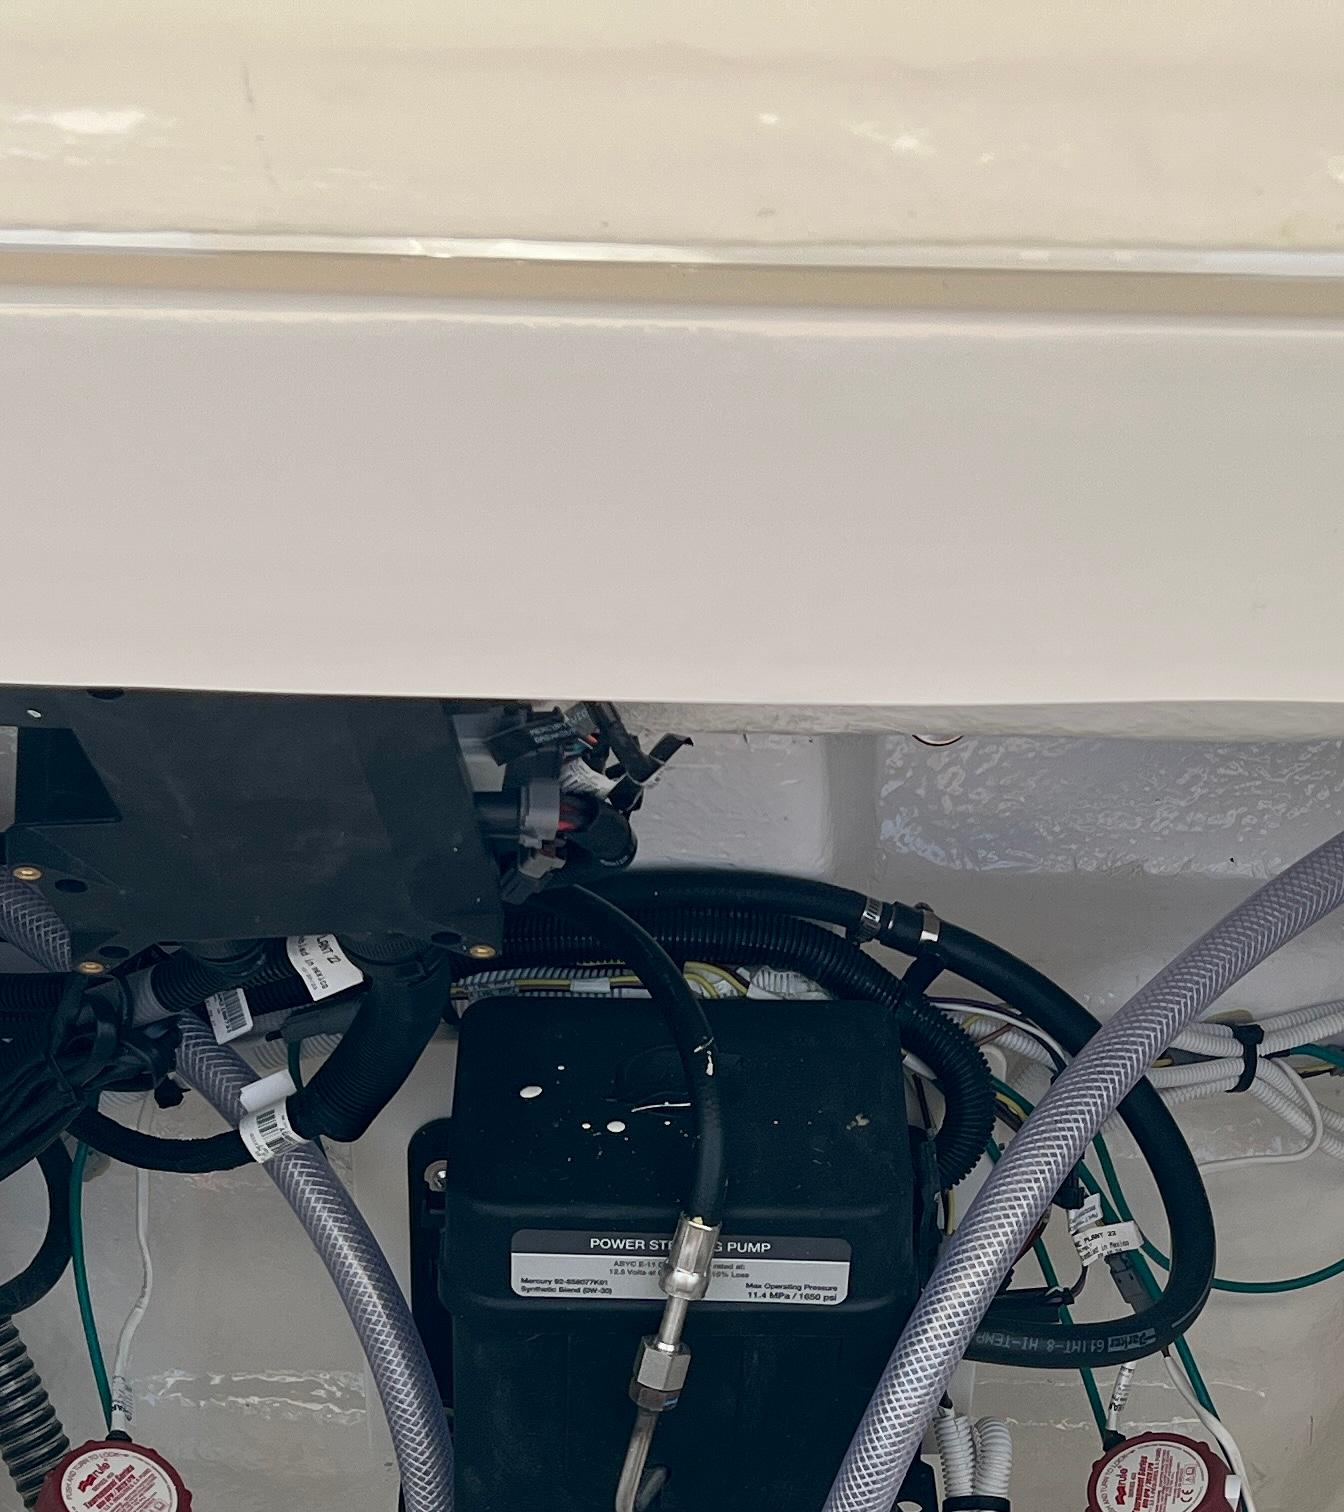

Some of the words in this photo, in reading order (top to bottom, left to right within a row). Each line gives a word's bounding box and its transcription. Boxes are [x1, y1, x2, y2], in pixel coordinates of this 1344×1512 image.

[590, 1238, 645, 1250] POWER
[727, 1242, 771, 1253] PUMP
[520, 1277, 552, 1286] Mercury
[520, 1286, 556, 1294] Synthetic
[764, 1283, 802, 1291] Operating
[748, 1291, 766, 1299] 11.4
[769, 1292, 790, 1300] MPa
